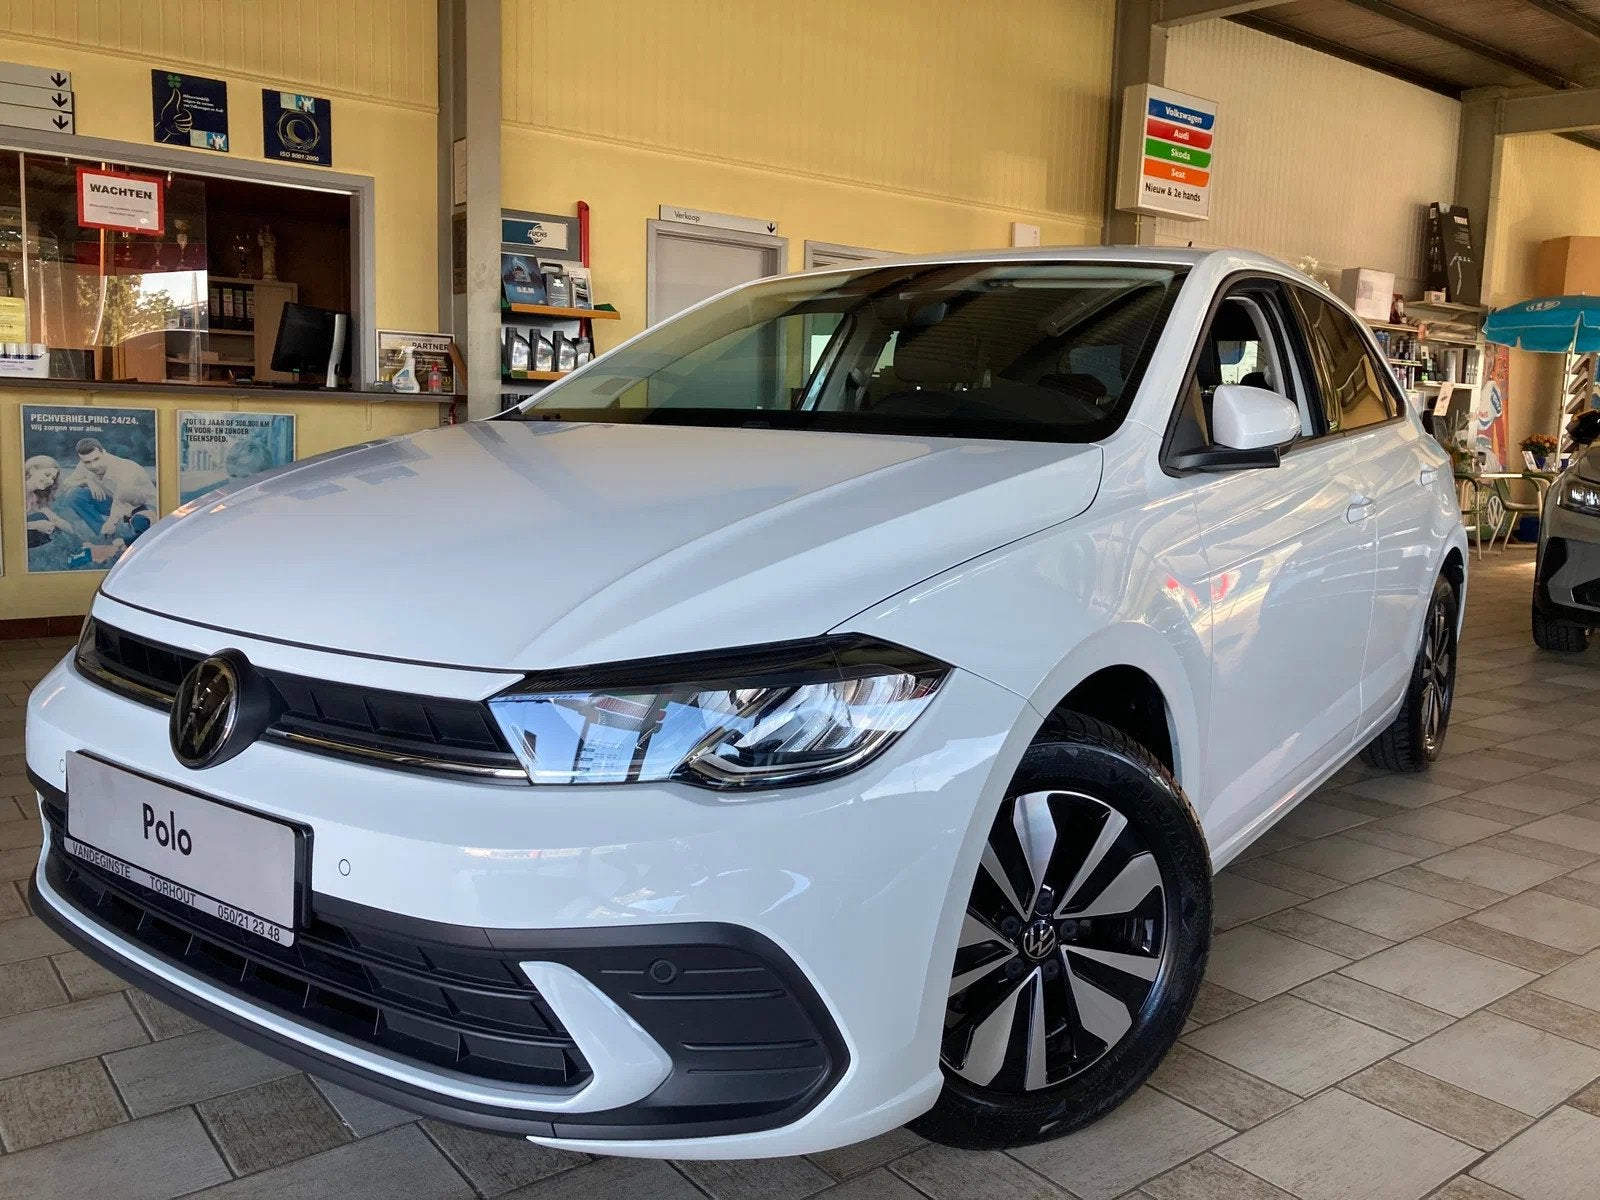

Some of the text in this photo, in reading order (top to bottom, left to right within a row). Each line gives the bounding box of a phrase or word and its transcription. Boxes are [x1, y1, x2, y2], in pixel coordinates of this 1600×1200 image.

[1166, 106, 1202, 124] Volkswagen
[1174, 129, 1190, 140] Audi
[1170, 148, 1190, 160] Skoda
[1171, 168, 1186, 179] Seat
[90, 184, 153, 200] WACHTEN
[1145, 182, 1201, 202] Nieuw & 2e hands
[674, 211, 700, 222] Verkoop
[412, 342, 448, 351] PARTNER
[30, 414, 139, 424] PECHVERHELPING 24/24.
[142, 802, 192, 856] Polo
[73, 842, 280, 942] VANDEGINSTE TORHOUT 050/21 23 48
